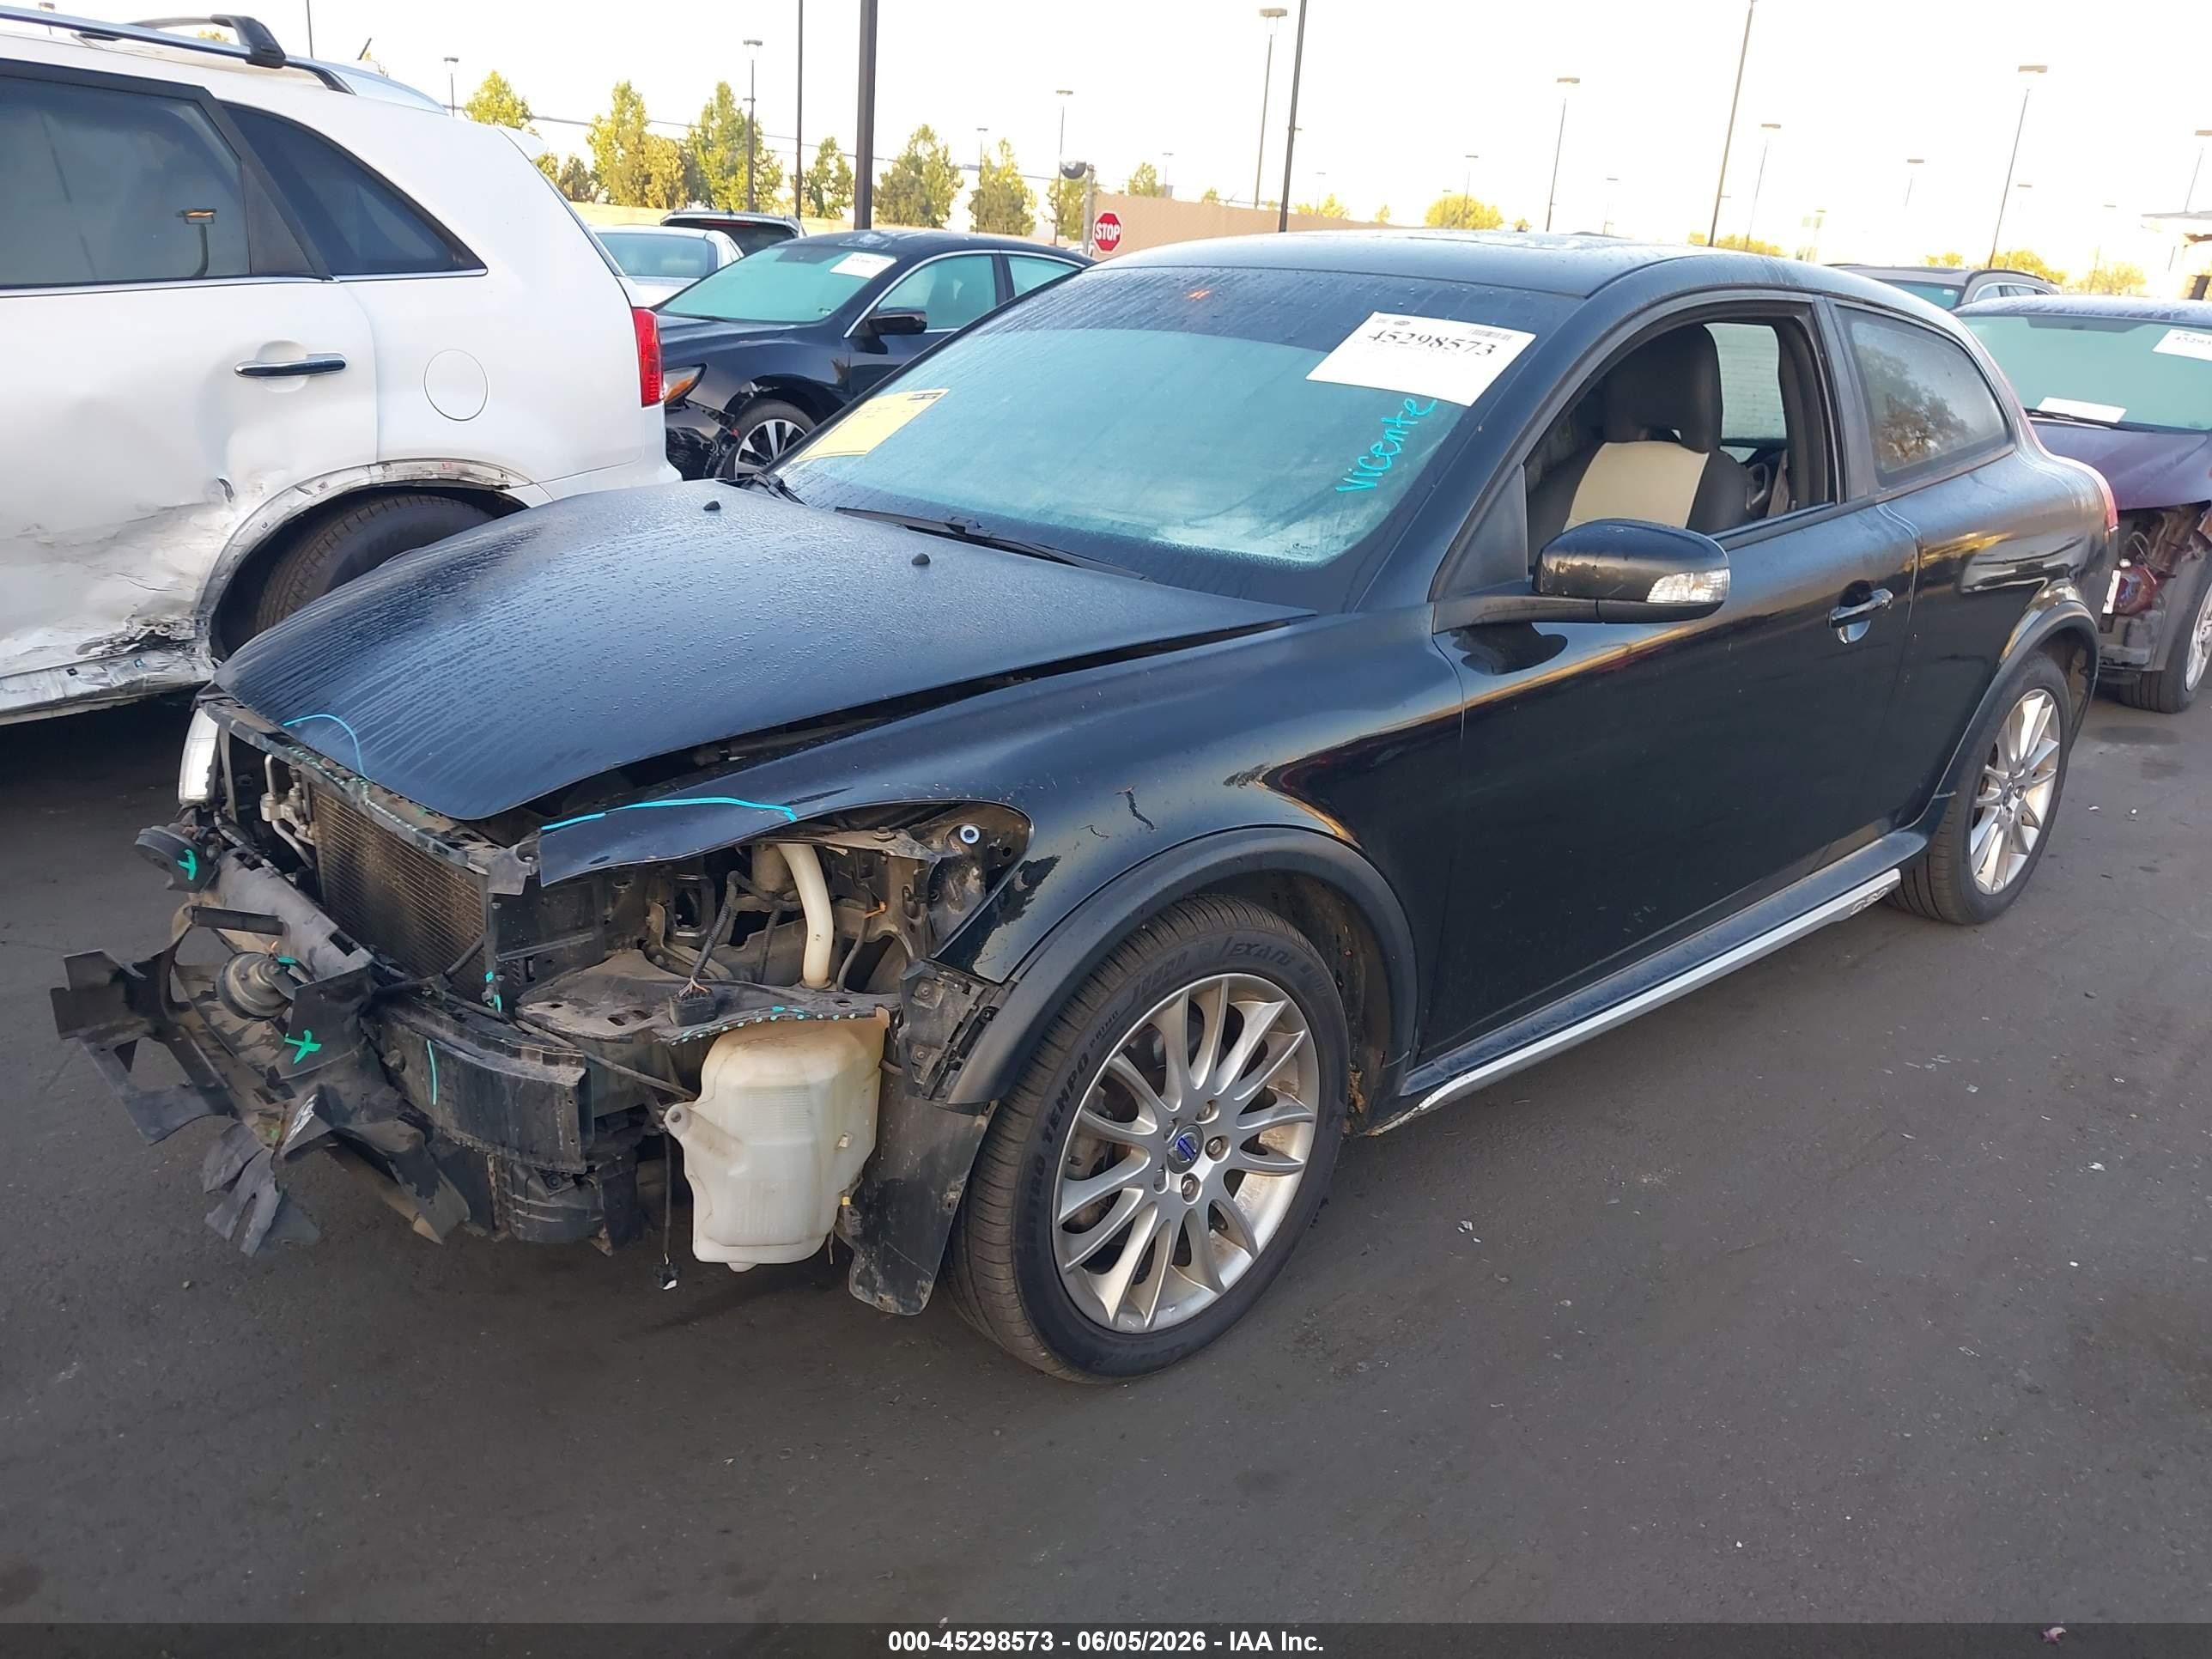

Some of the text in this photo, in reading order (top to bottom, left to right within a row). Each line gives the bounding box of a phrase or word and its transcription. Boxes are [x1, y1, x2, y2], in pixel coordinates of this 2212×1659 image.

[1095, 222, 1121, 241] STOP
[1367, 330, 1497, 356] 45298573
[1042, 1052, 1089, 1144] TEMPO
